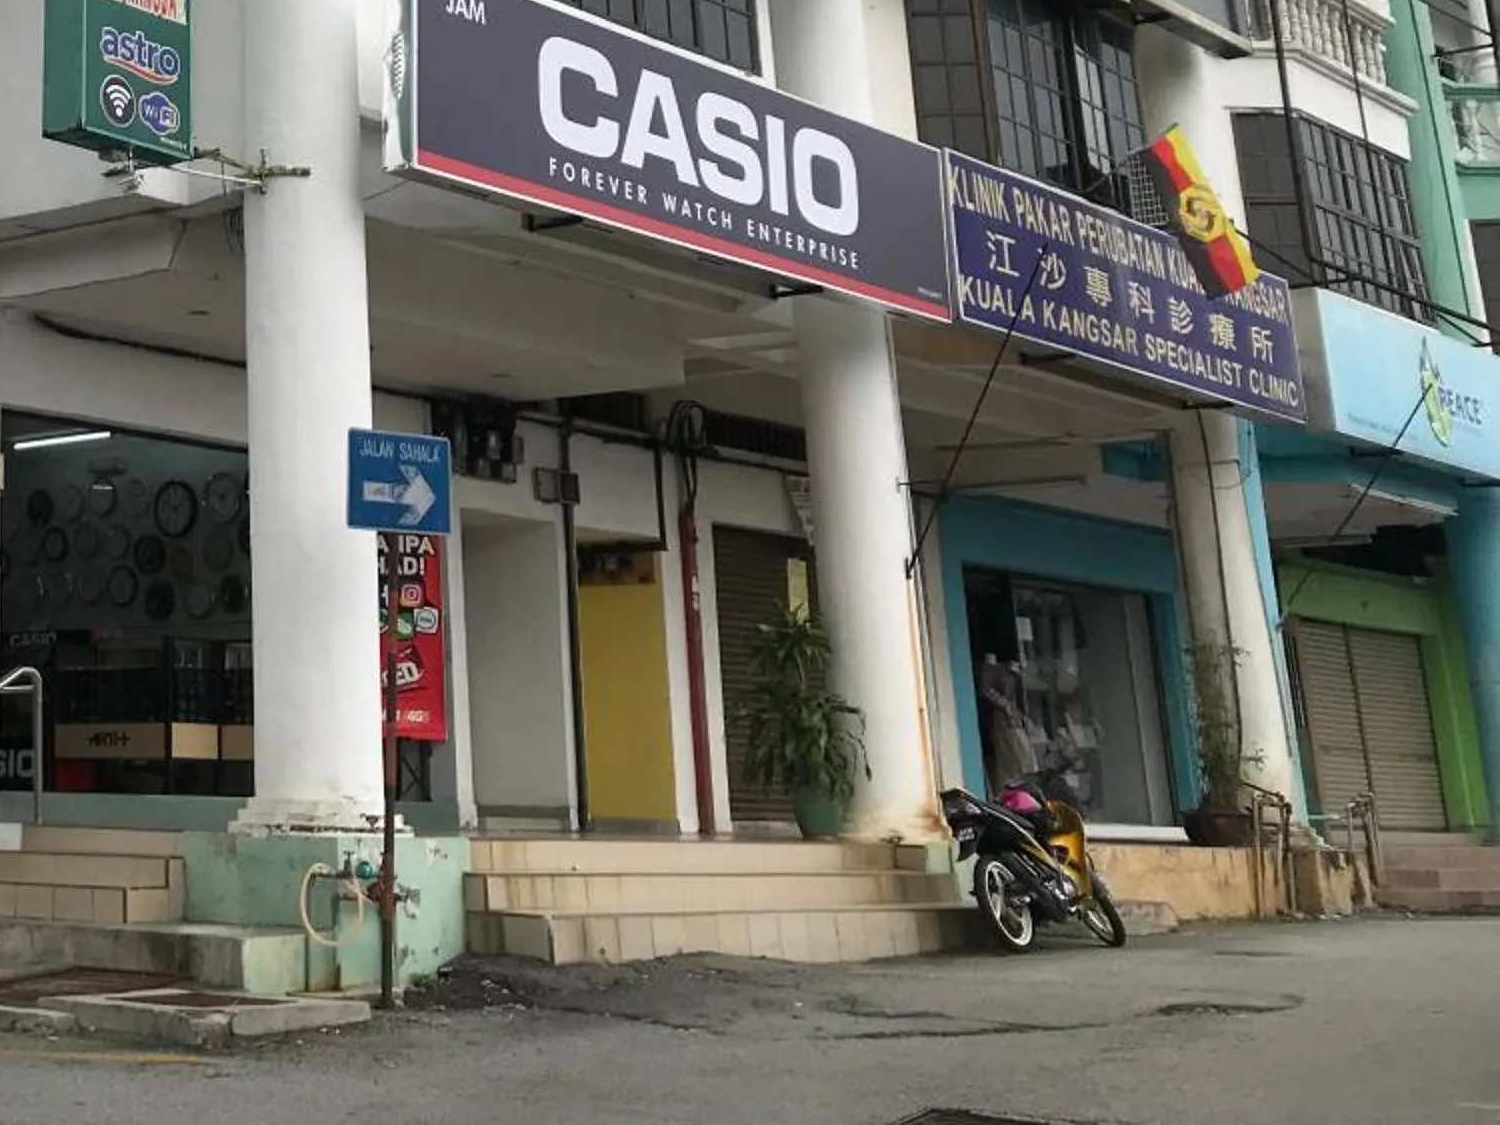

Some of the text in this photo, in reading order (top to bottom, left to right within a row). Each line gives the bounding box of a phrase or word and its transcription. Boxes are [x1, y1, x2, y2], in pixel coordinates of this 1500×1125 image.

[100, 26, 180, 77] astro
[537, 35, 860, 237] CASIO
[548, 156, 860, 271] FOREVER WATCH ENTERPRISE
[950, 166, 1011, 224] KLINIK
[1013, 187, 1076, 247] PAKAR
[1076, 210, 1166, 281] PERUBATAN
[961, 273, 1300, 409] KUALA KANGSAR SPECIALIST CLINIC
[359, 437, 395, 458] JALAN
